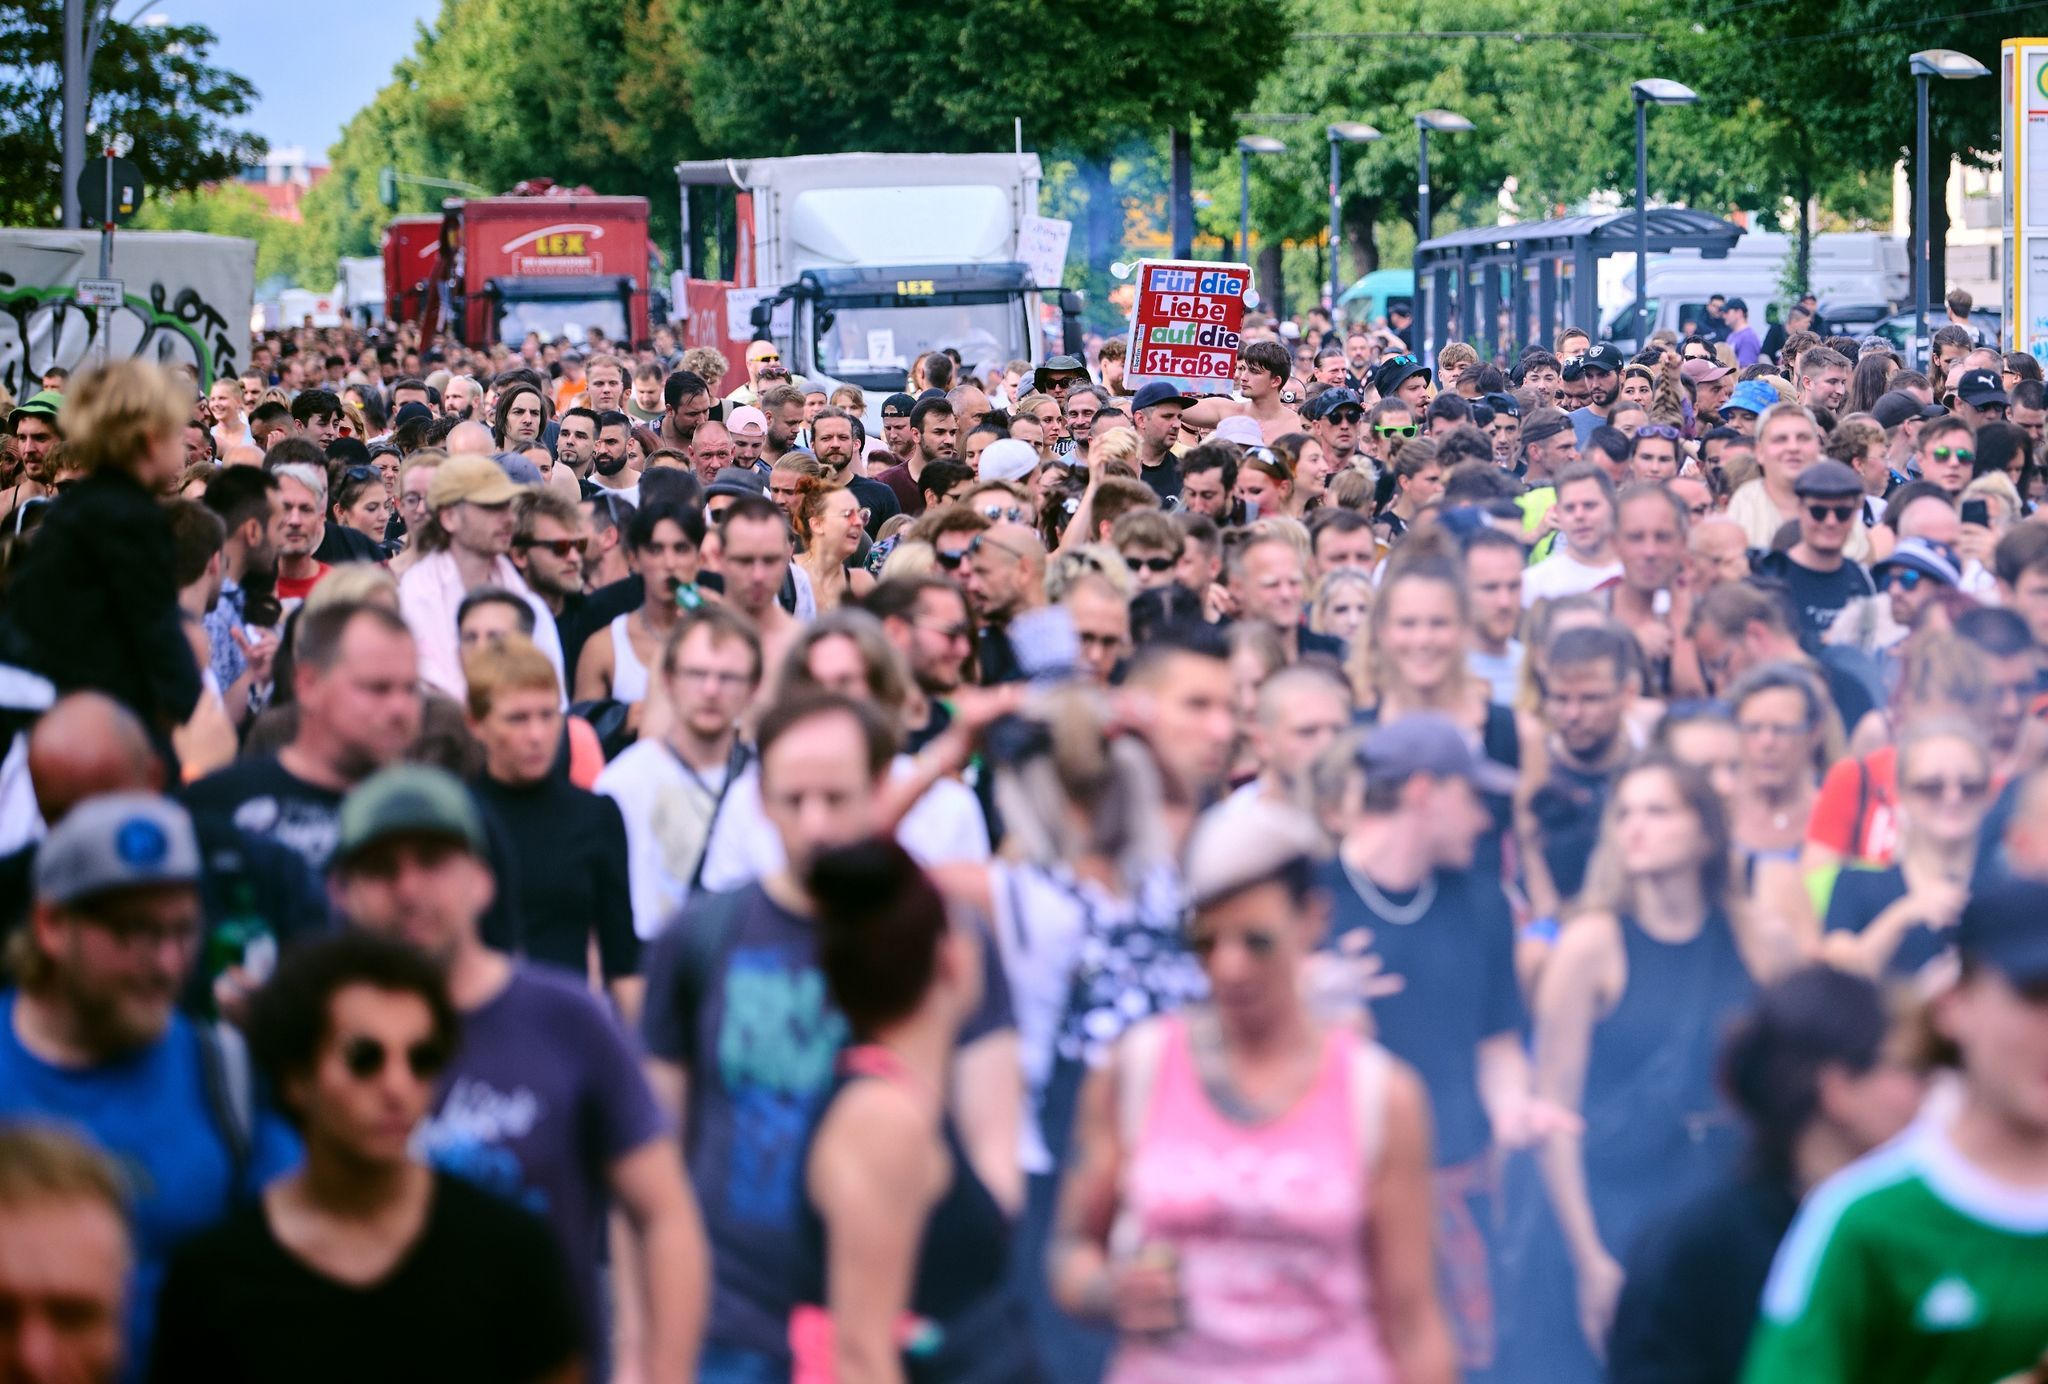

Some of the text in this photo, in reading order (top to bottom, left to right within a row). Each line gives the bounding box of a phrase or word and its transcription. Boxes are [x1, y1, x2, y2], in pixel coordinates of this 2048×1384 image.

[536, 233, 585, 256] LEX
[896, 279, 936, 296] LEX
[1151, 270, 1241, 295] Für die
[1154, 295, 1225, 321] Liebe
[1151, 323, 1239, 349] auf die
[1146, 351, 1229, 377] Straße
